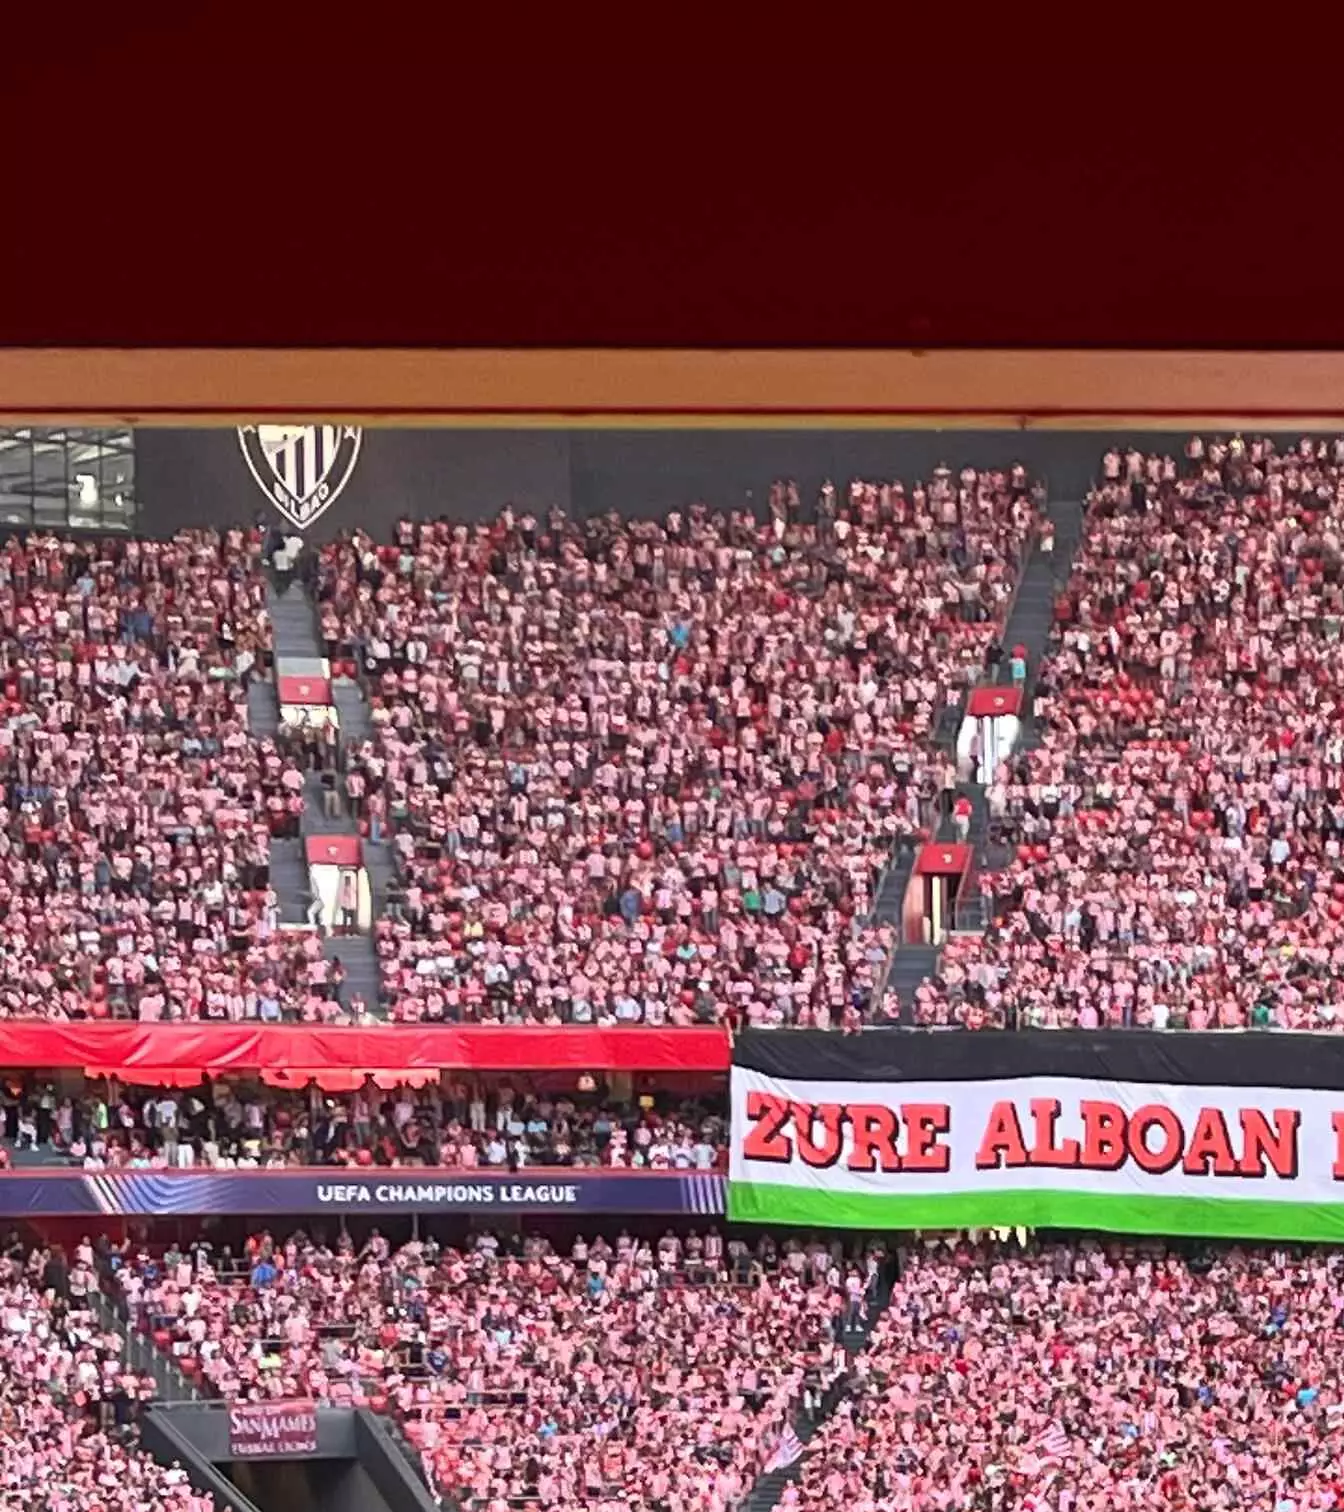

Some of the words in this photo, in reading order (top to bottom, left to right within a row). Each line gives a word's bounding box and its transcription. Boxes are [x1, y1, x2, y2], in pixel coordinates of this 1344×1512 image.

[743, 1091, 951, 1174] ZURE
[975, 1098, 1301, 1180] ALBOAN
[317, 1185, 370, 1202] UEFA
[375, 1184, 494, 1202] CHAMPIONS
[500, 1185, 577, 1202] LEAGUE
